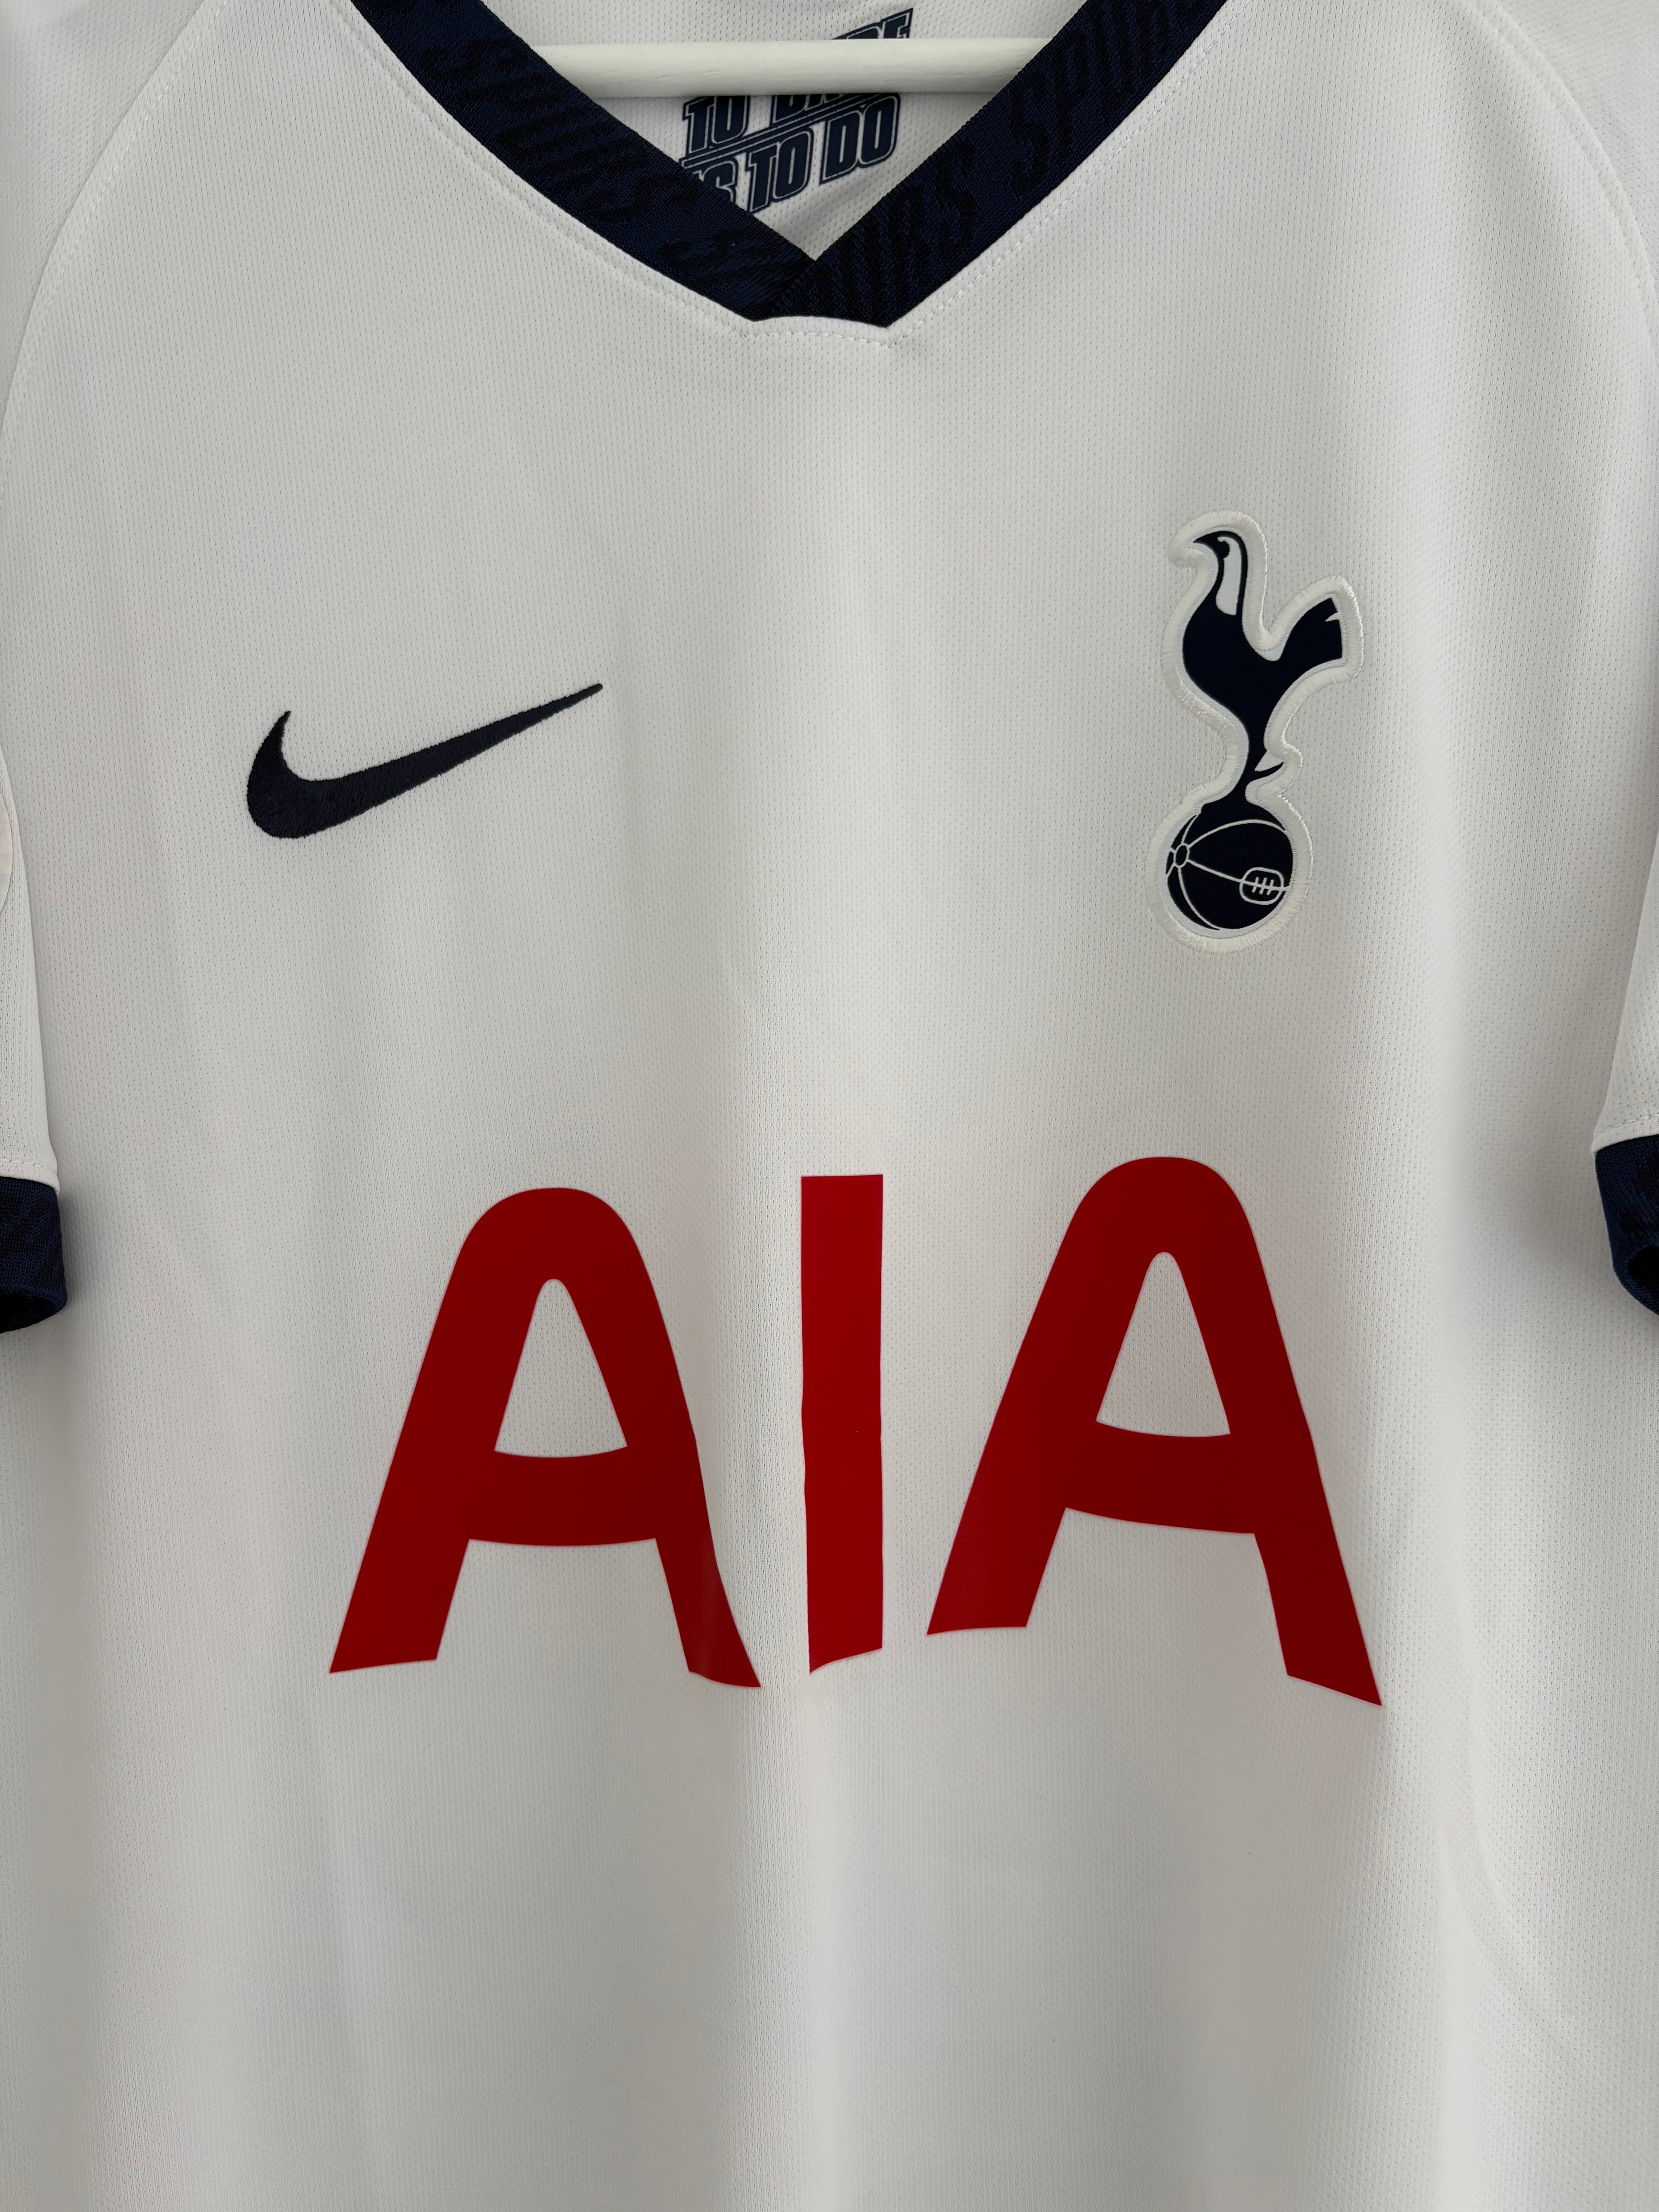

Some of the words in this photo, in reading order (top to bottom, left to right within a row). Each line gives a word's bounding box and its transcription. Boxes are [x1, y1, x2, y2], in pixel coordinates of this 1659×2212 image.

[683, 95, 750, 156] TO
[744, 126, 814, 215] TO
[818, 92, 901, 186] DO
[330, 1157, 1381, 1705] AIA
